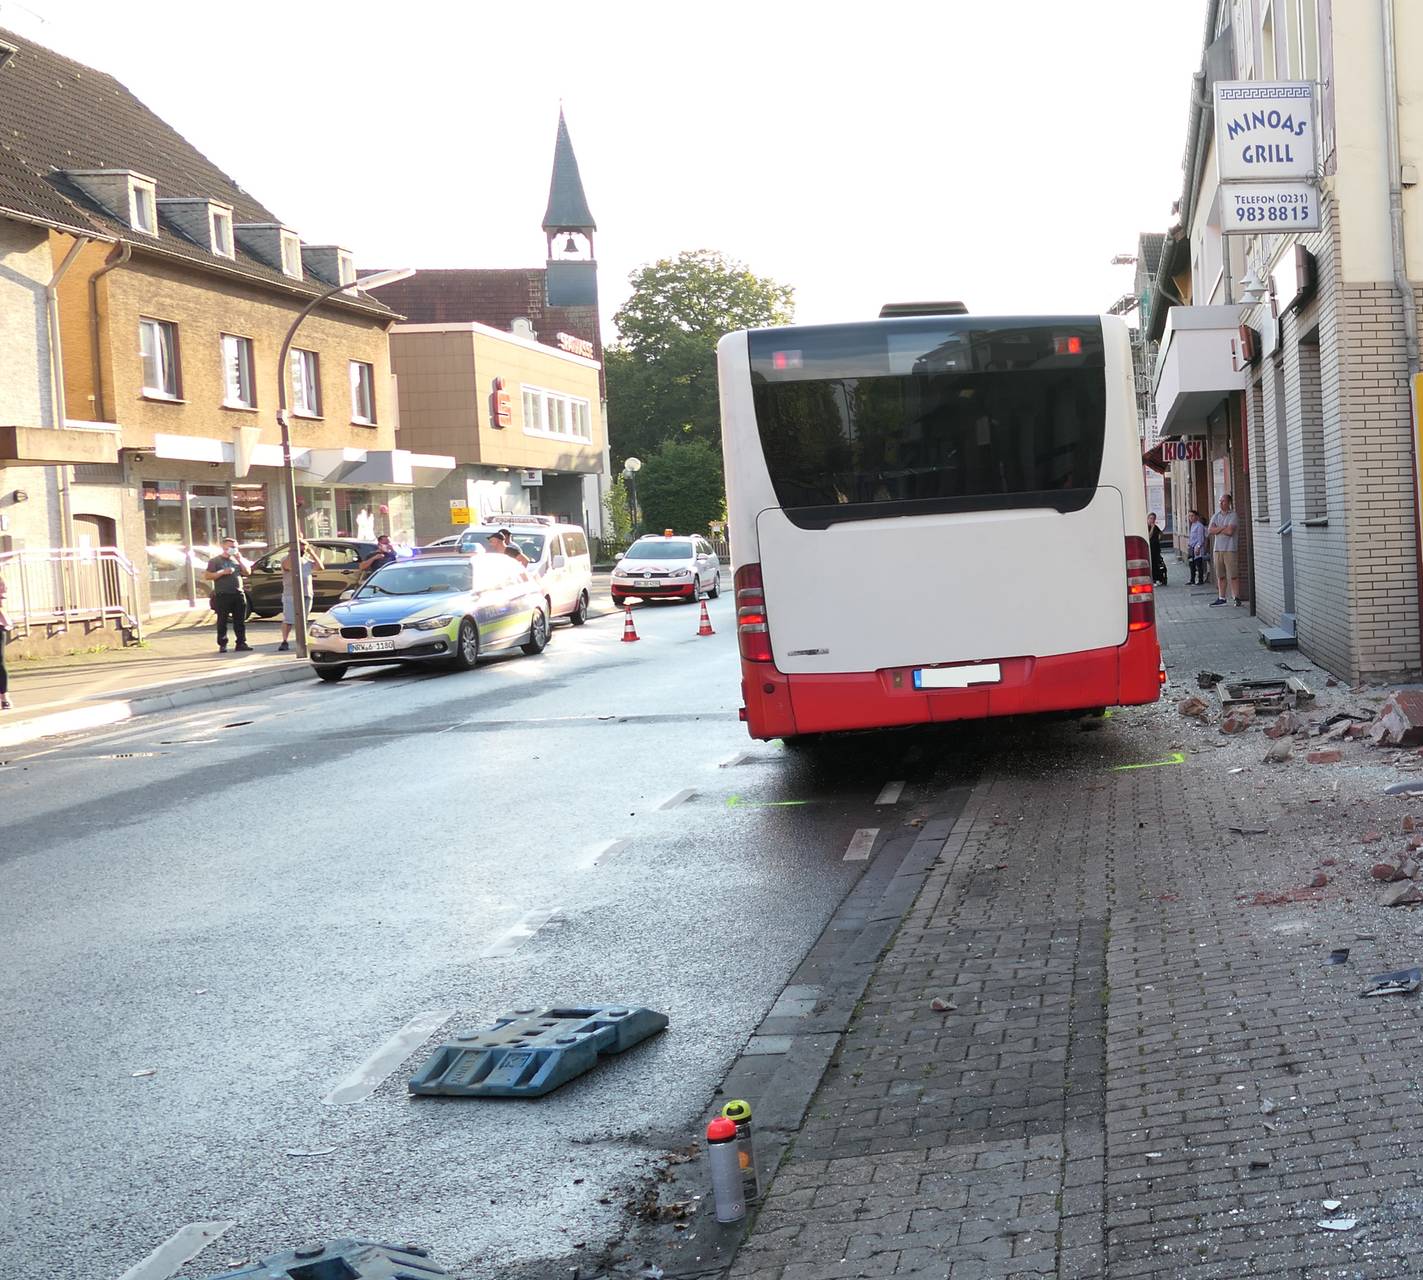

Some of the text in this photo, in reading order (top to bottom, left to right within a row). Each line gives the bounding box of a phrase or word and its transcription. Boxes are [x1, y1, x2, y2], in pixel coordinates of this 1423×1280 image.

[1226, 110, 1307, 140] MINOAS
[1242, 144, 1294, 163] GRILL
[1277, 193, 1308, 204] (0231)
[1164, 441, 1201, 460] KIOSK
